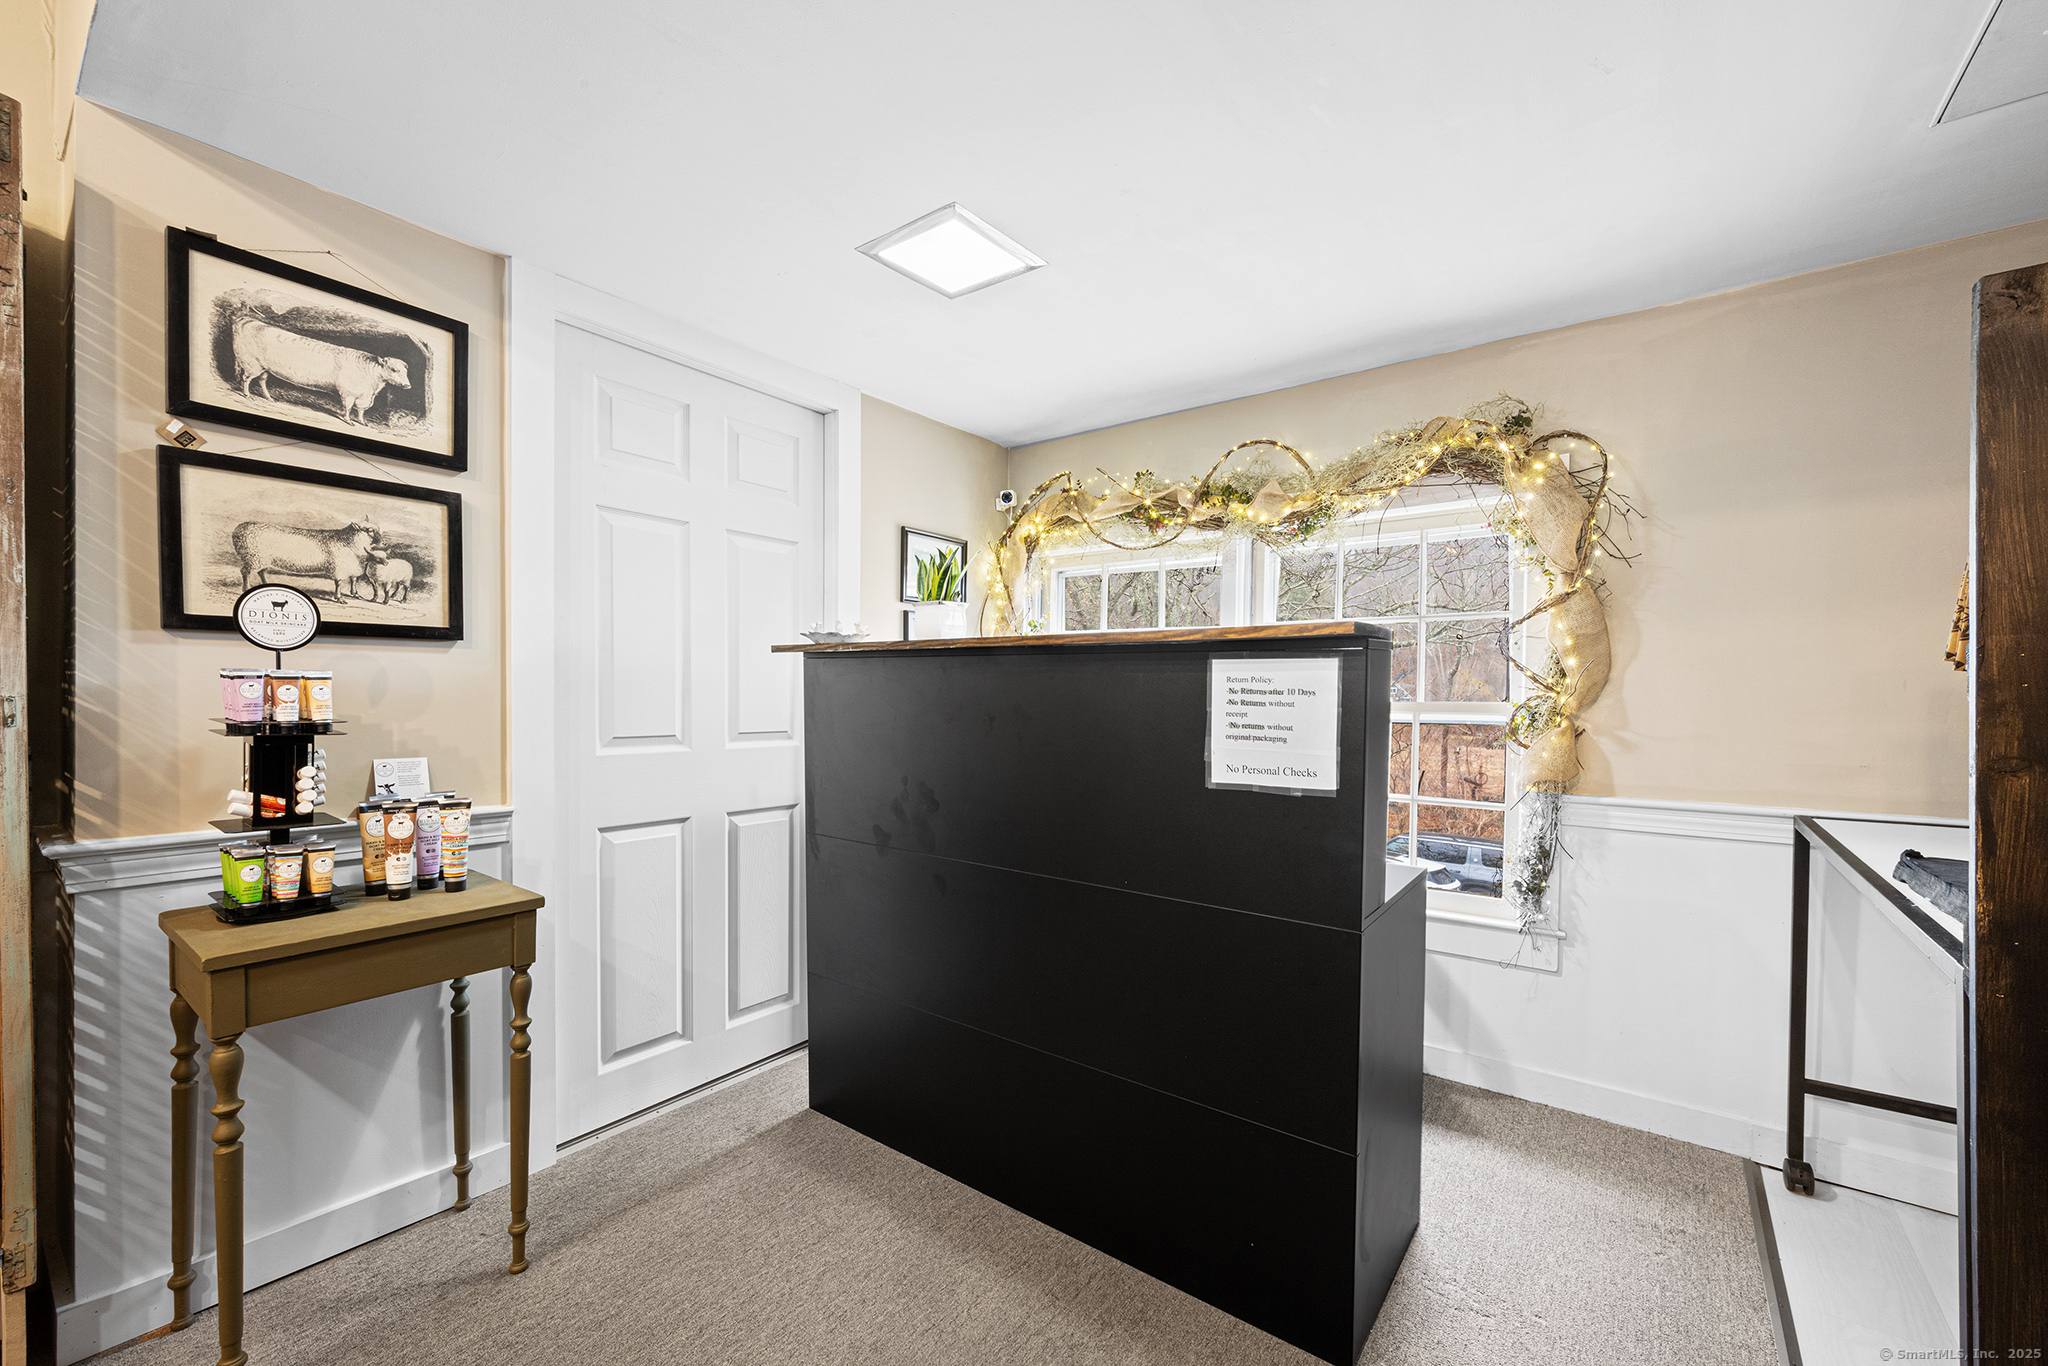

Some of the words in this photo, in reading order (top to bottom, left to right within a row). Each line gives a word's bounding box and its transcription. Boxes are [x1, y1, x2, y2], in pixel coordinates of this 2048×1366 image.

[248, 610, 308, 621] DIONIS
[1226, 676, 1249, 684] Return
[1250, 676, 1275, 685] Policy:
[1240, 688, 1267, 696] Returns
[1268, 688, 1285, 696] after
[1287, 688, 1296, 696] 10
[1297, 688, 1317, 698] Days
[1240, 699, 1267, 707] Returns
[1268, 700, 1295, 708] without
[1225, 711, 1248, 719] receipt
[1241, 722, 1265, 731] returns
[1266, 723, 1294, 732] without
[1225, 733, 1251, 743] original
[1252, 735, 1288, 745] packaging
[1226, 764, 1239, 773] No
[1242, 765, 1280, 776] Personal
[1282, 767, 1318, 778] Checks
